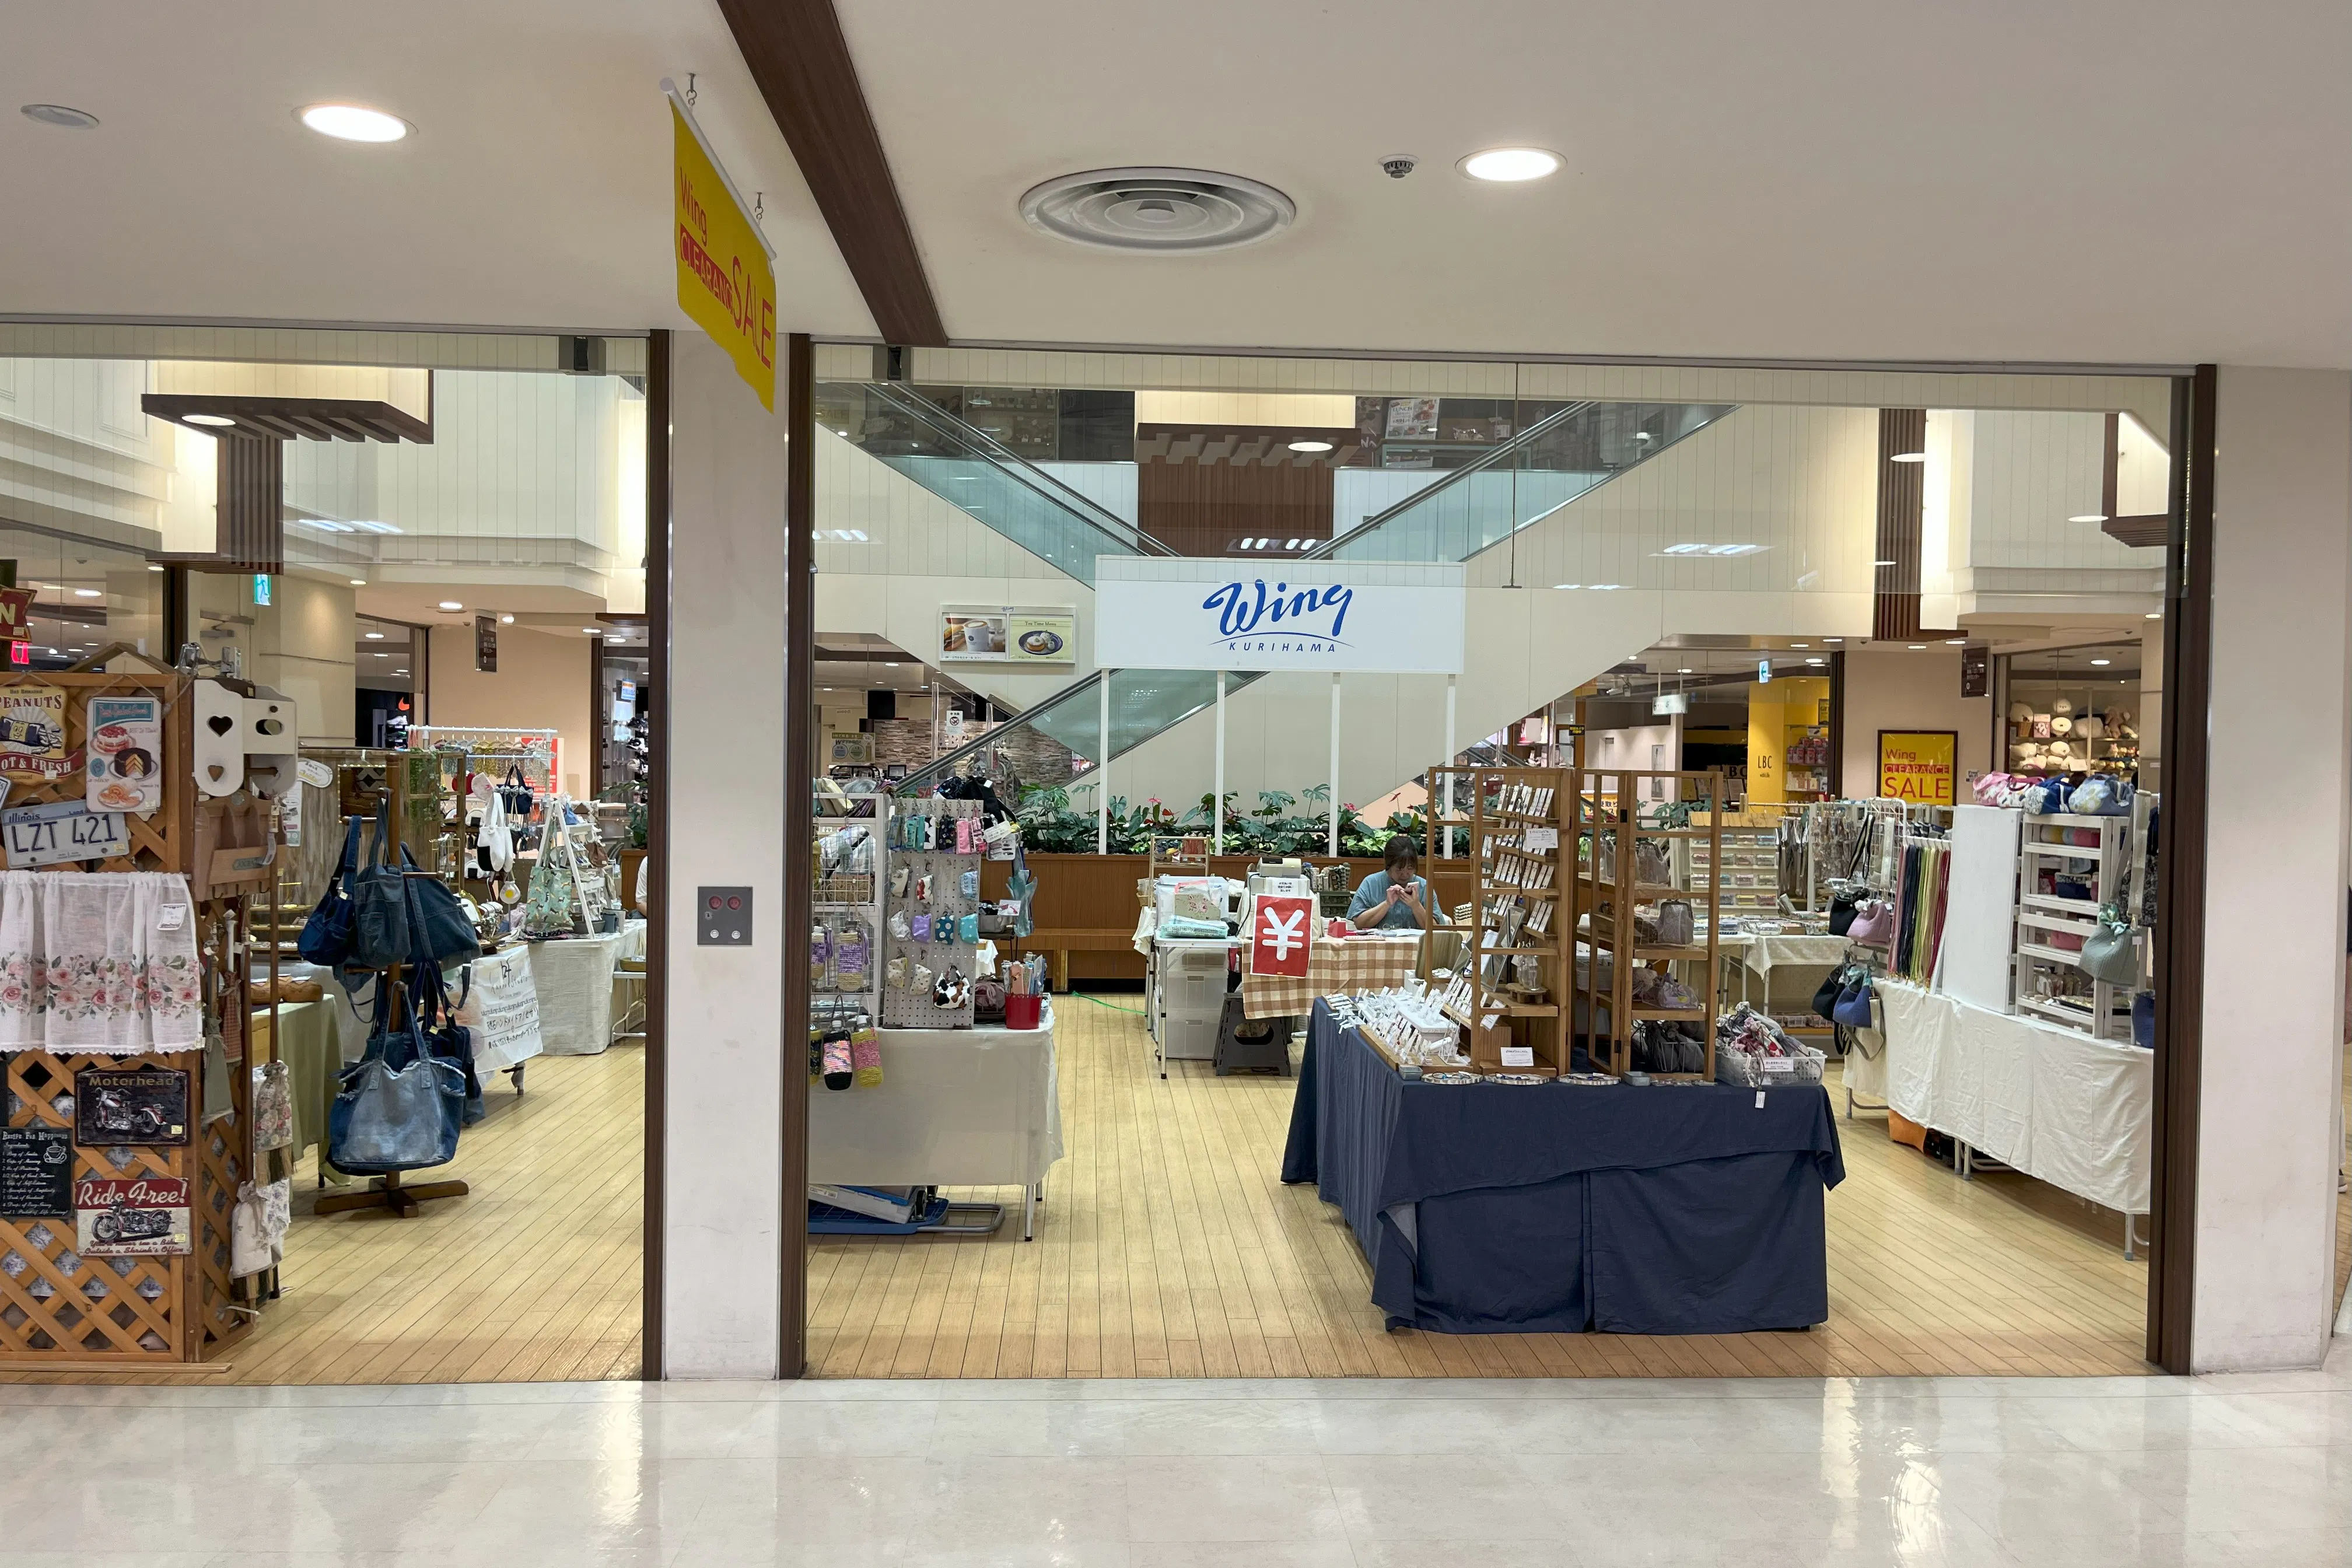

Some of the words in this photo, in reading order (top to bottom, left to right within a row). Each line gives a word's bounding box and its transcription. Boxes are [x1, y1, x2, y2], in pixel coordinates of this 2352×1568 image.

[680, 166, 707, 247] Wing
[680, 231, 733, 316] CLEARANC
[732, 256, 772, 370] SALE
[1202, 579, 1353, 636] Wing
[1229, 642, 1335, 652] KURIHAMA
[0, 694, 62, 709] EANUTS
[1758, 755, 1772, 768] LBC
[1885, 748, 1916, 762] Wing
[1, 757, 16, 770] OT
[19, 758, 27, 768] &
[32, 758, 71, 774] FRESH
[1885, 765, 1950, 774] CLEARANCE
[1884, 776, 1950, 799] SALE
[9, 813, 40, 822] Illinois
[11, 821, 58, 853] LZT
[72, 814, 117, 845] 421
[89, 1076, 174, 1086] Motorhead
[78, 1181, 125, 1206] Ride
[128, 1181, 188, 1205] Free!
